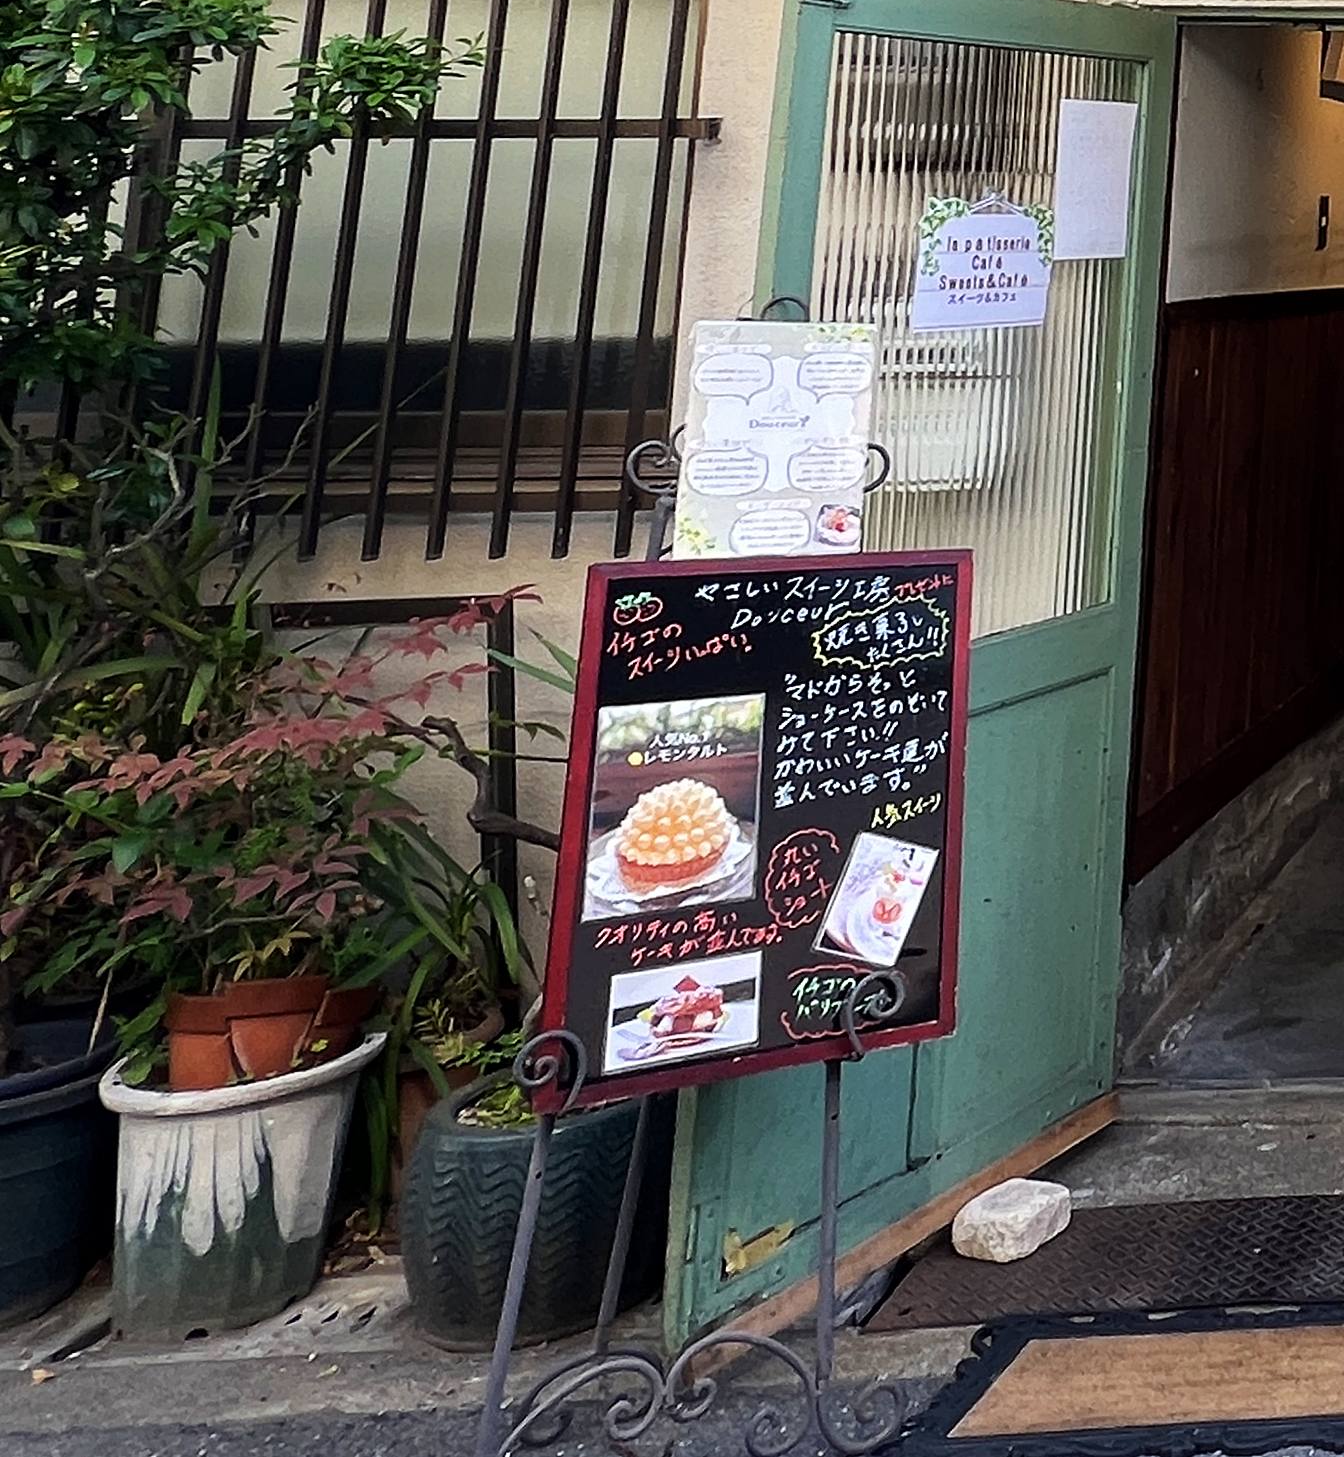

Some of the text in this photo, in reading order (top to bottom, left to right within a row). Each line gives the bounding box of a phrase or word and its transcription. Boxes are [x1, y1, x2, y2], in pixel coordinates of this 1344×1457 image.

[730, 601, 850, 630] Douceur
[643, 742, 728, 765] レモンタルト
